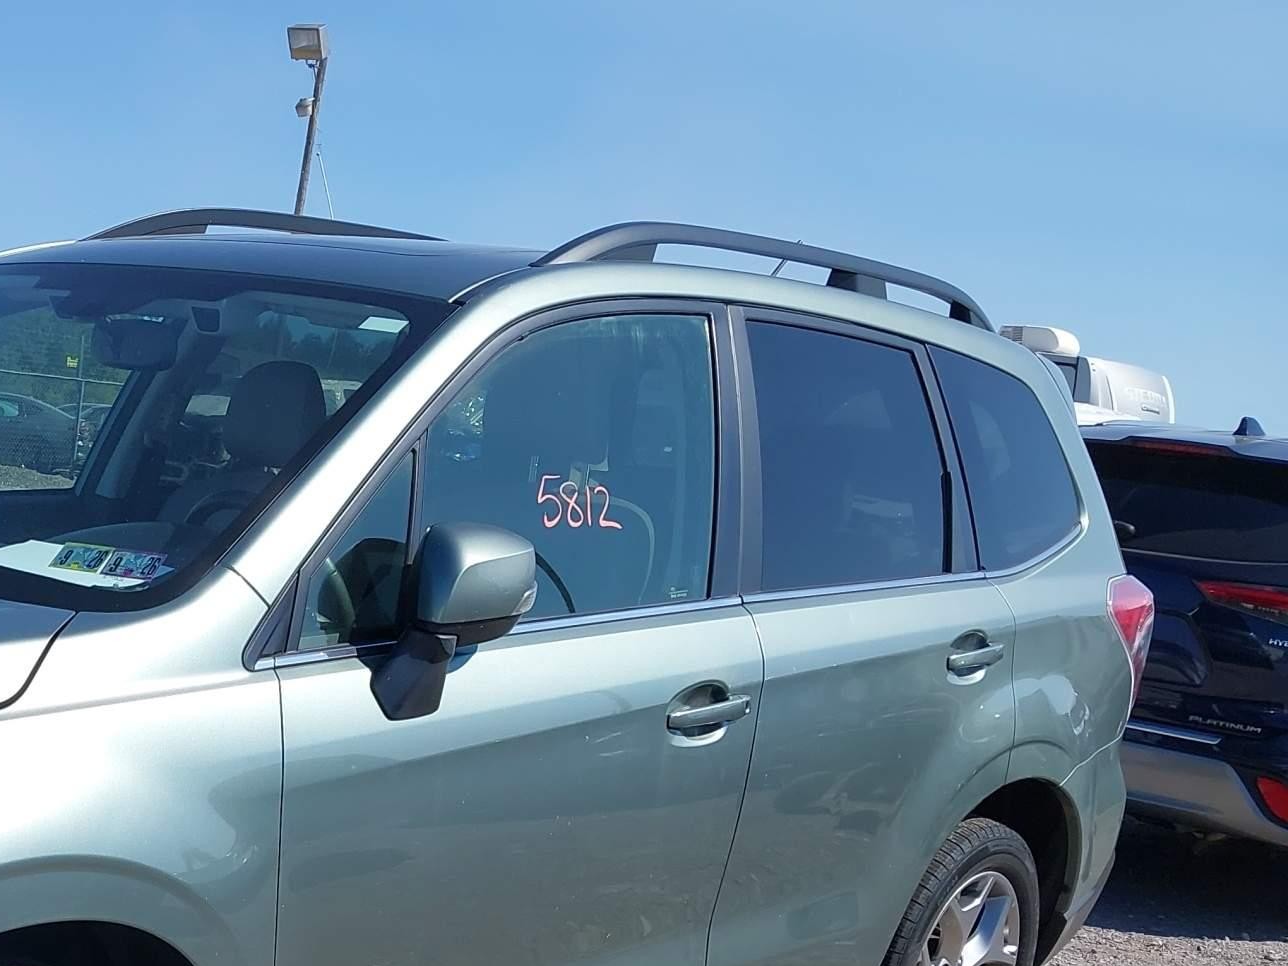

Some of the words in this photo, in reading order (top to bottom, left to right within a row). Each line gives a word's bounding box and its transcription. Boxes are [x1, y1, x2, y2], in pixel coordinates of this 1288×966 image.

[537, 474, 623, 530] 5812
[87, 550, 109, 570] 26
[140, 556, 161, 576] 26
[1187, 714, 1263, 734] PLATINUM
